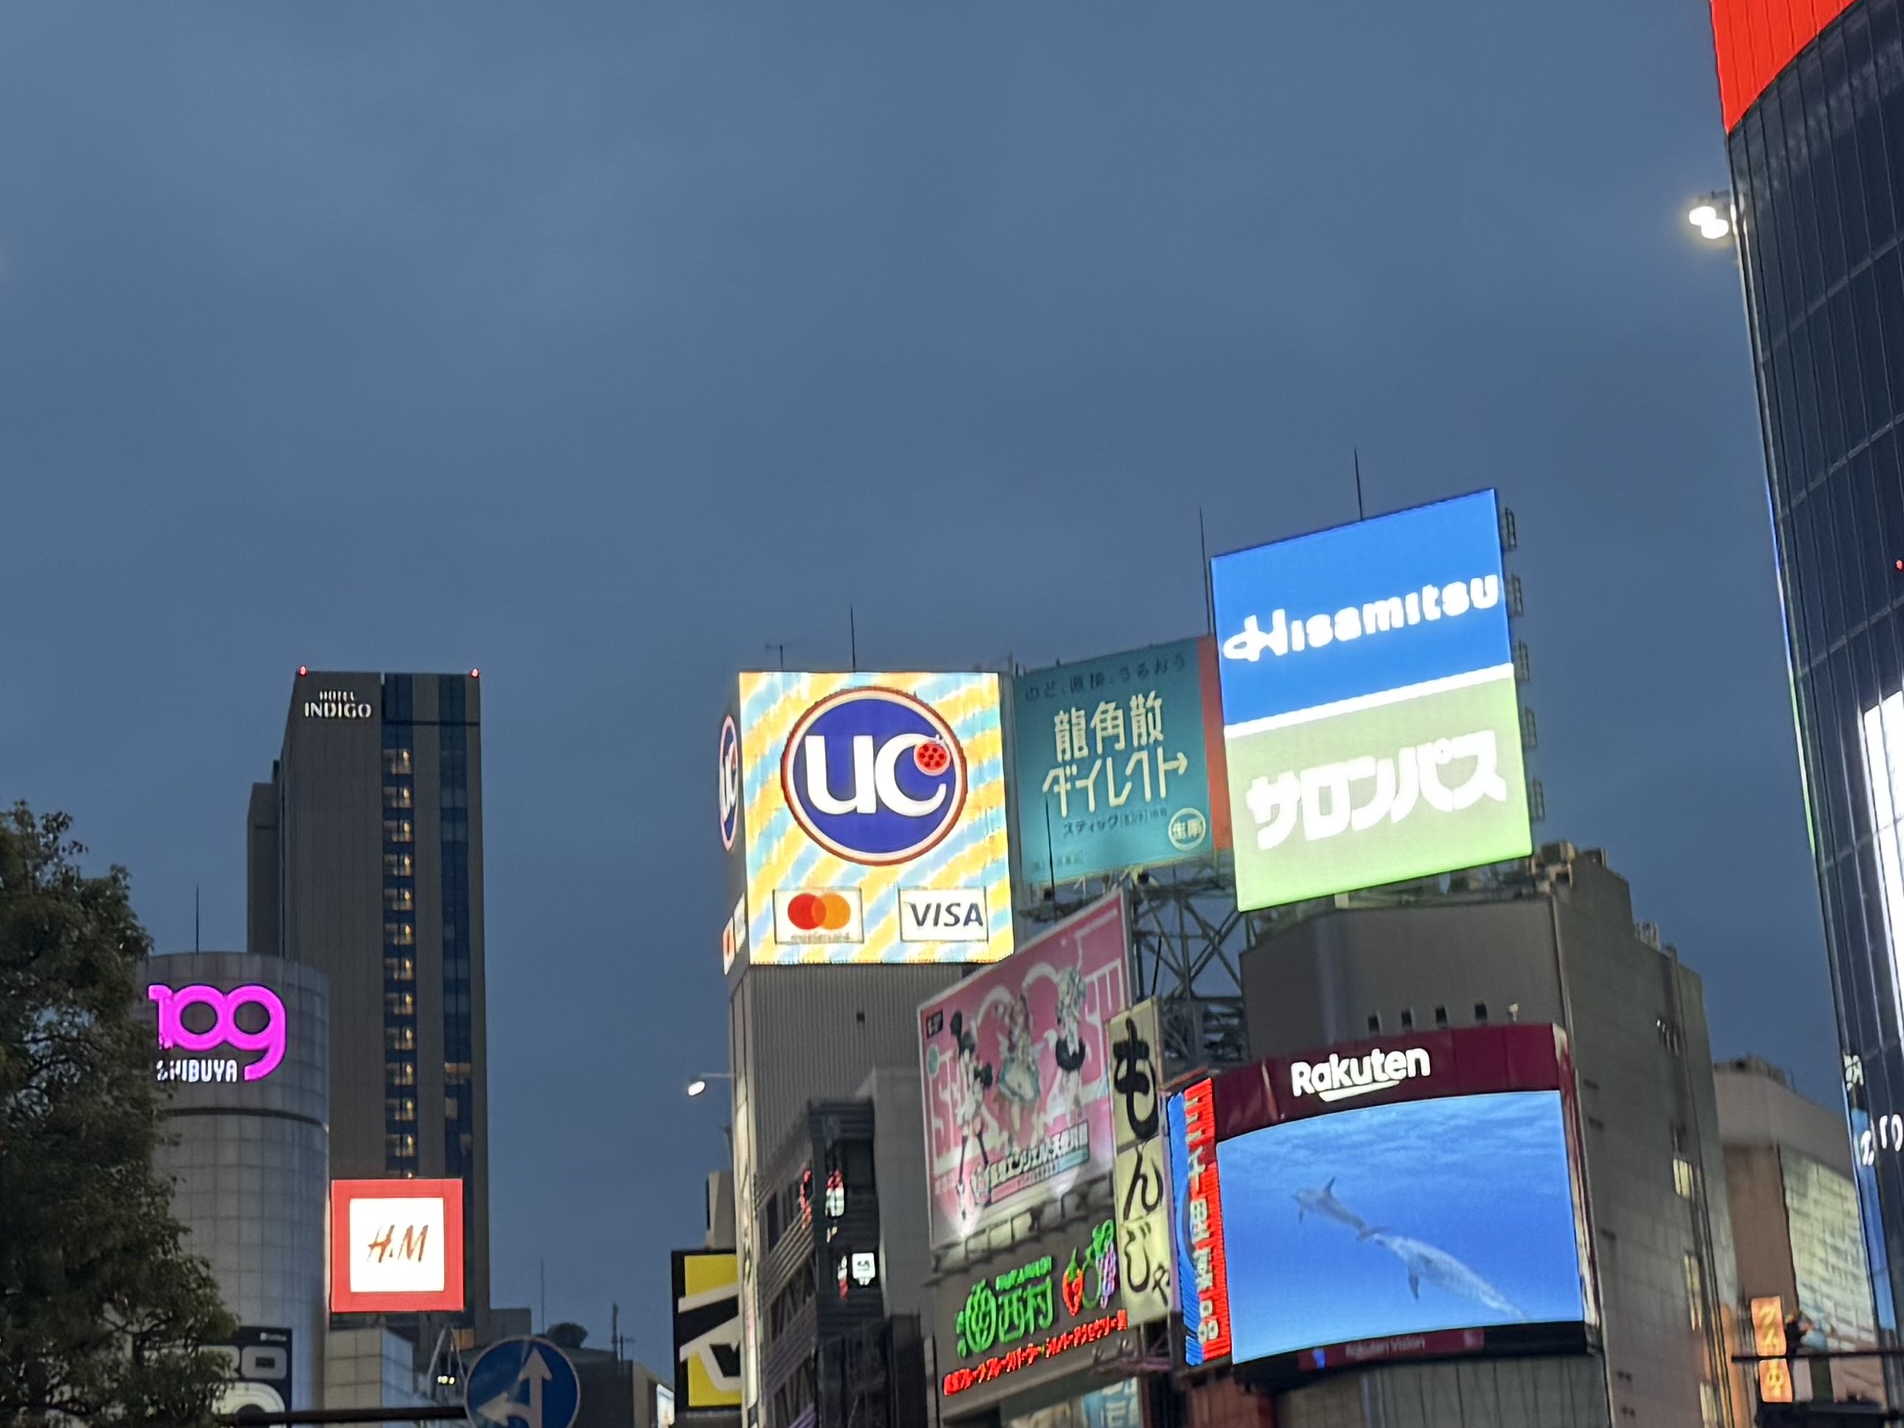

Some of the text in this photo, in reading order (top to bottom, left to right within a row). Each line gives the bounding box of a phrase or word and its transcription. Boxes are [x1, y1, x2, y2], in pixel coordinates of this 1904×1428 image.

[1223, 574, 1499, 663] Hisamitsu
[303, 702, 372, 719] INDIGO
[1054, 690, 1164, 763] 龍角散
[1042, 746, 1189, 818] ダイレクト
[1246, 729, 1508, 851] サロンパス
[908, 901, 984, 928] VISA
[147, 983, 288, 1083] 109
[1291, 1048, 1432, 1099] Rakuten
[1112, 1016, 1172, 1309] もんじゃ
[366, 1222, 430, 1265] H&M
